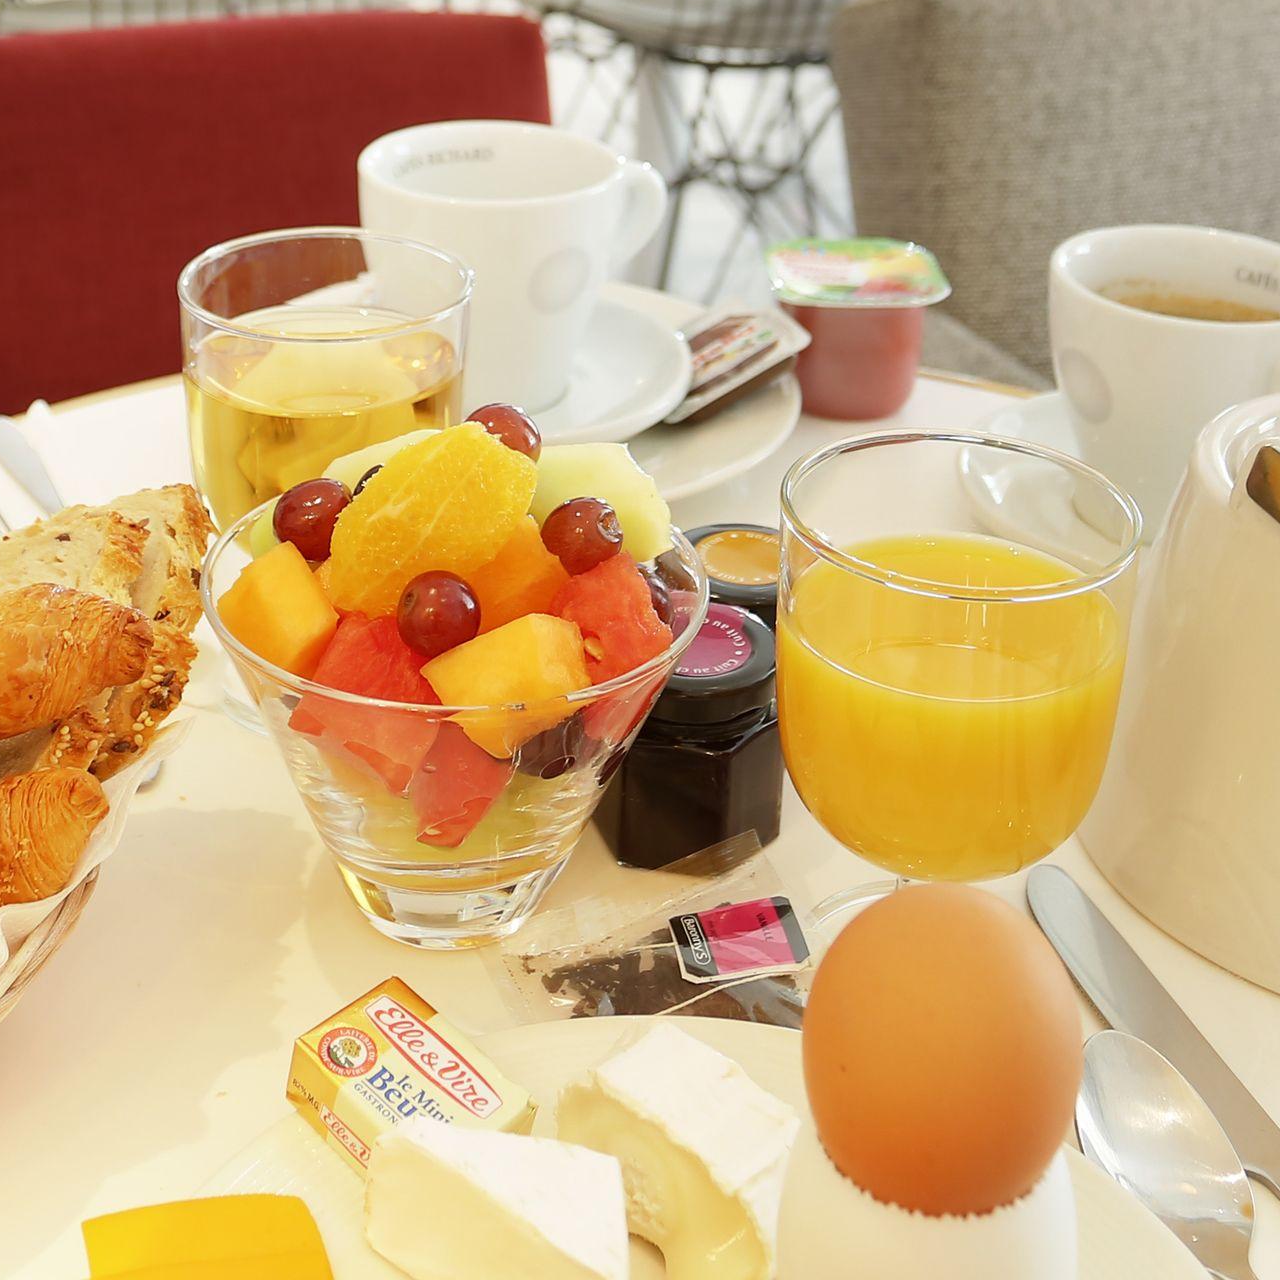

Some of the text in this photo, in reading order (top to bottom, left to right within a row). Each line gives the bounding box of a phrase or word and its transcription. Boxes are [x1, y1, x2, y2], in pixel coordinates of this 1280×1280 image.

[374, 1006, 489, 1112] Elle & Vire
[353, 1082, 399, 1127] GASTRON
[366, 1065, 426, 1118] Beu
[396, 1074, 413, 1093] le
[322, 1111, 350, 1145] Elle
